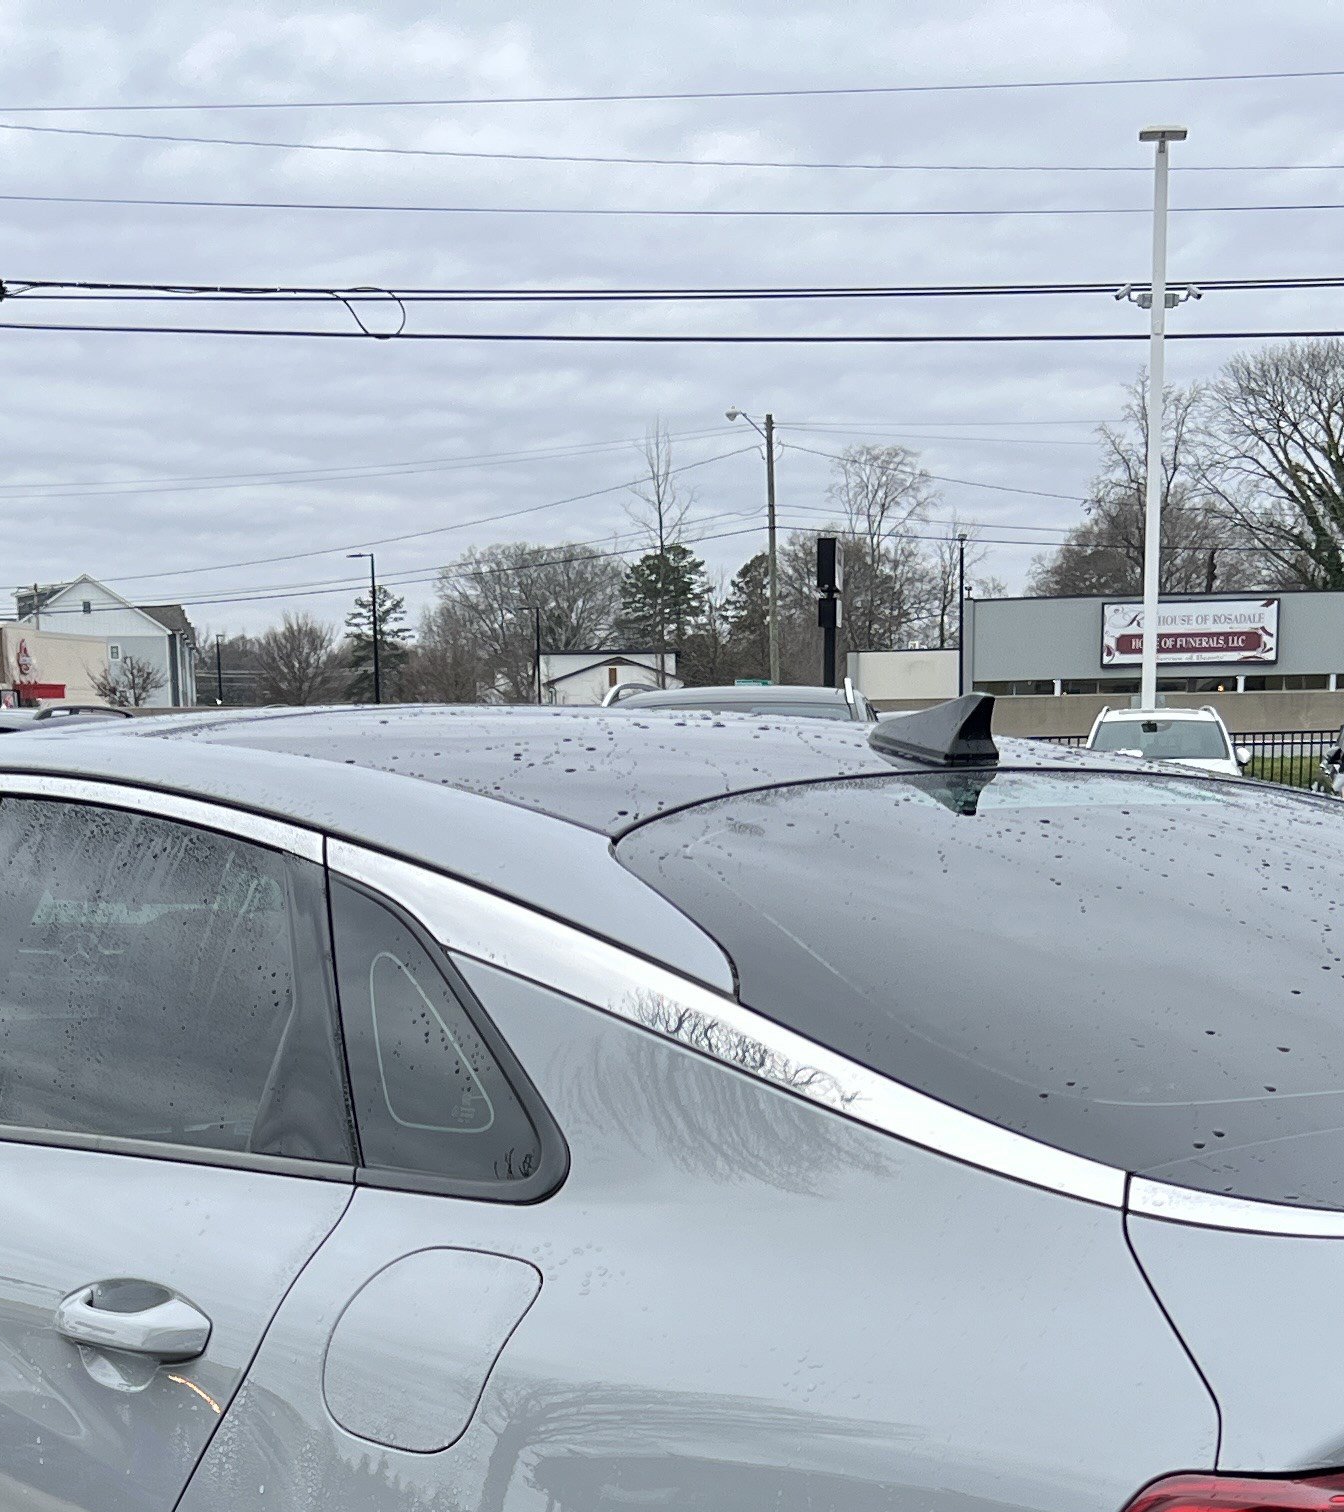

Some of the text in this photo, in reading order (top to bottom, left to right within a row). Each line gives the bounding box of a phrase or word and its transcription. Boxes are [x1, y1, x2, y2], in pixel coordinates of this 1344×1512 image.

[1157, 615, 1193, 626] HOUSE
[1195, 615, 1209, 624] OF
[1212, 612, 1265, 625] ROSADALE
[1161, 637, 1175, 649] OF
[1176, 636, 1227, 648] FUNERALS,
[1228, 636, 1246, 647] LLC
